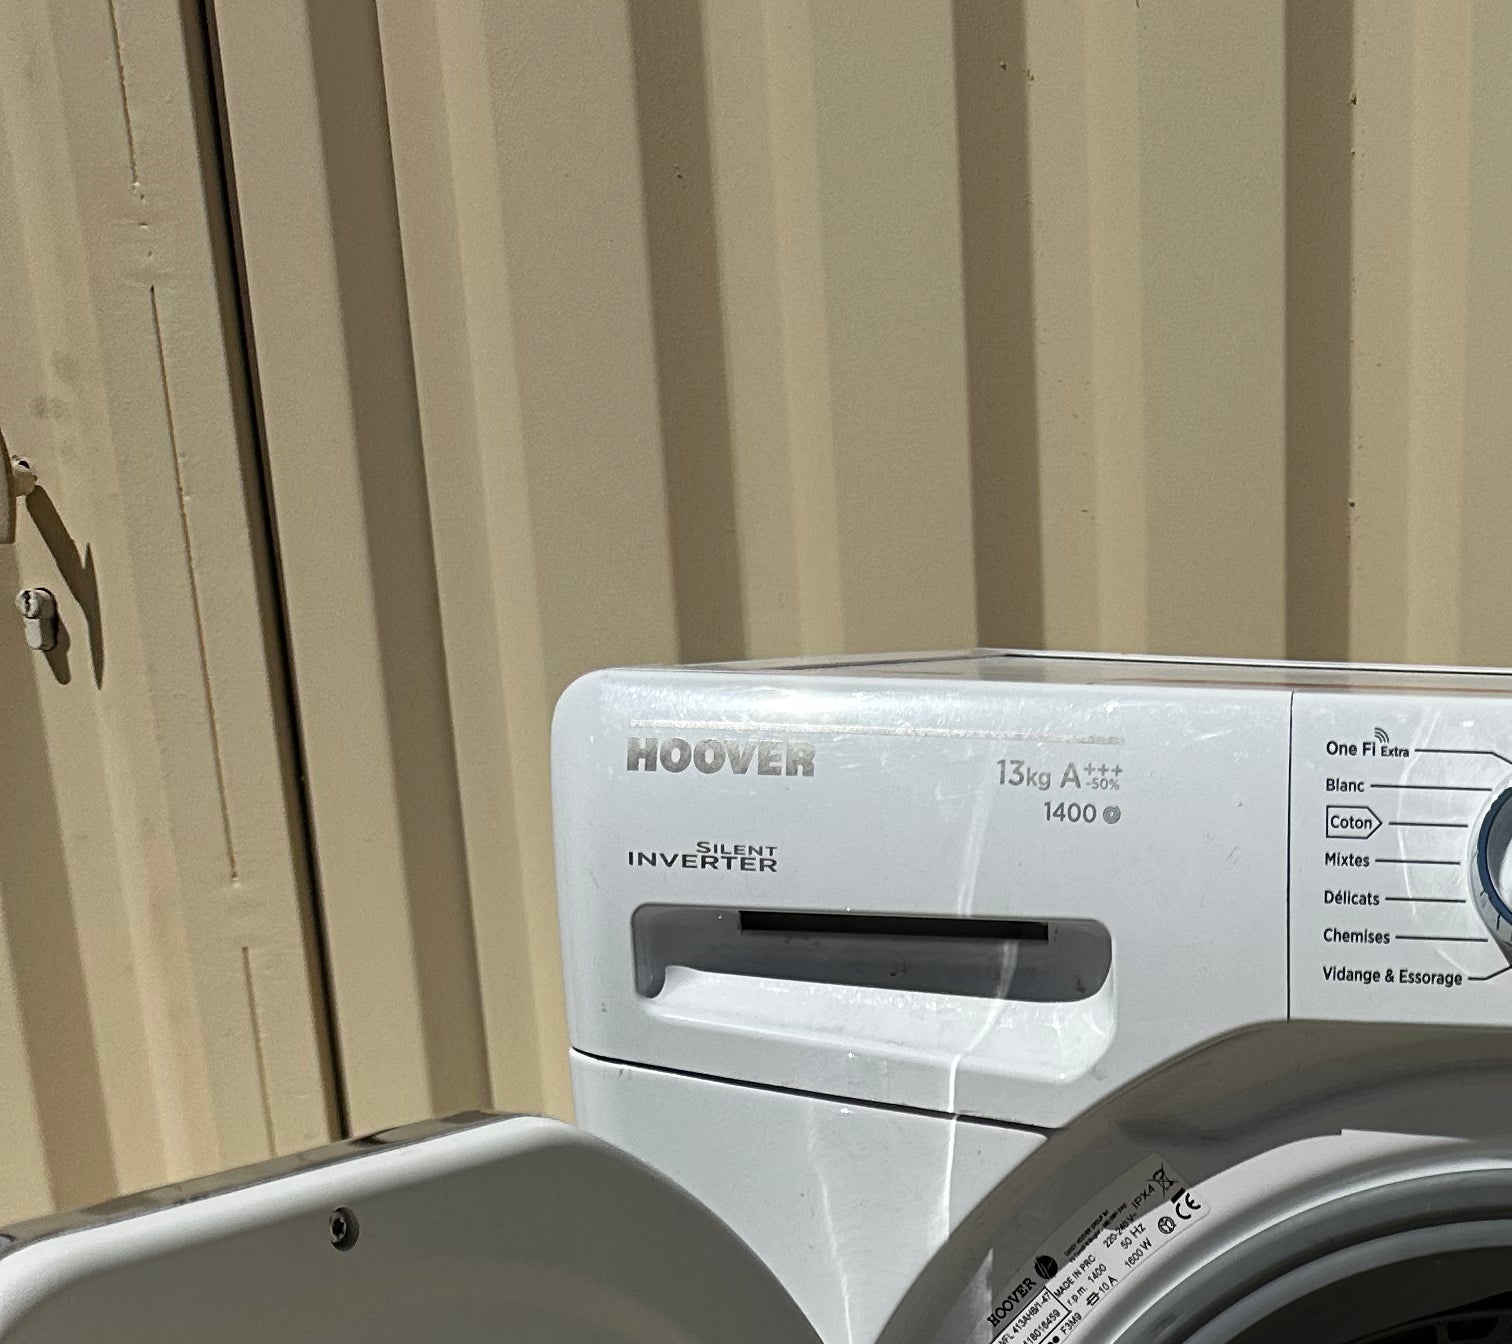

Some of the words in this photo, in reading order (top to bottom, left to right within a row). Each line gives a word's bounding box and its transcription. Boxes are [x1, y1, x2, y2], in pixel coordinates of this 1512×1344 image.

[627, 737, 815, 777] HOOVER
[1326, 741, 1358, 758] One
[1381, 744, 1409, 758] Extra
[997, 759, 1051, 791] 13kg
[1326, 778, 1364, 793] Blanc
[1044, 802, 1096, 823] 1400
[1330, 815, 1372, 830] Coton
[696, 841, 778, 856] SILENT
[628, 852, 778, 872] INVERTER
[1325, 853, 1370, 868] Mixtes
[1324, 890, 1380, 906] Délicats
[1324, 929, 1390, 945] Chemises
[1323, 966, 1380, 985] Vidange
[1385, 969, 1394, 983] &
[1399, 969, 1462, 988] Essorage
[1132, 1184, 1155, 1209] IPX4
[1120, 1237, 1132, 1249] 50
[1130, 1223, 1146, 1238] Hz
[1125, 1249, 1143, 1268] 1600
[1140, 1237, 1152, 1251] W
[1055, 1276, 1074, 1298] MADE
[1072, 1270, 1081, 1279] IN
[1080, 1254, 1096, 1272] PRC
[1088, 1264, 1106, 1283] 1400
[1099, 1283, 1109, 1294] 10
[1108, 1275, 1118, 1287] A
[987, 1277, 1036, 1327] HOOVER
[1060, 1313, 1082, 1335] F3M9
